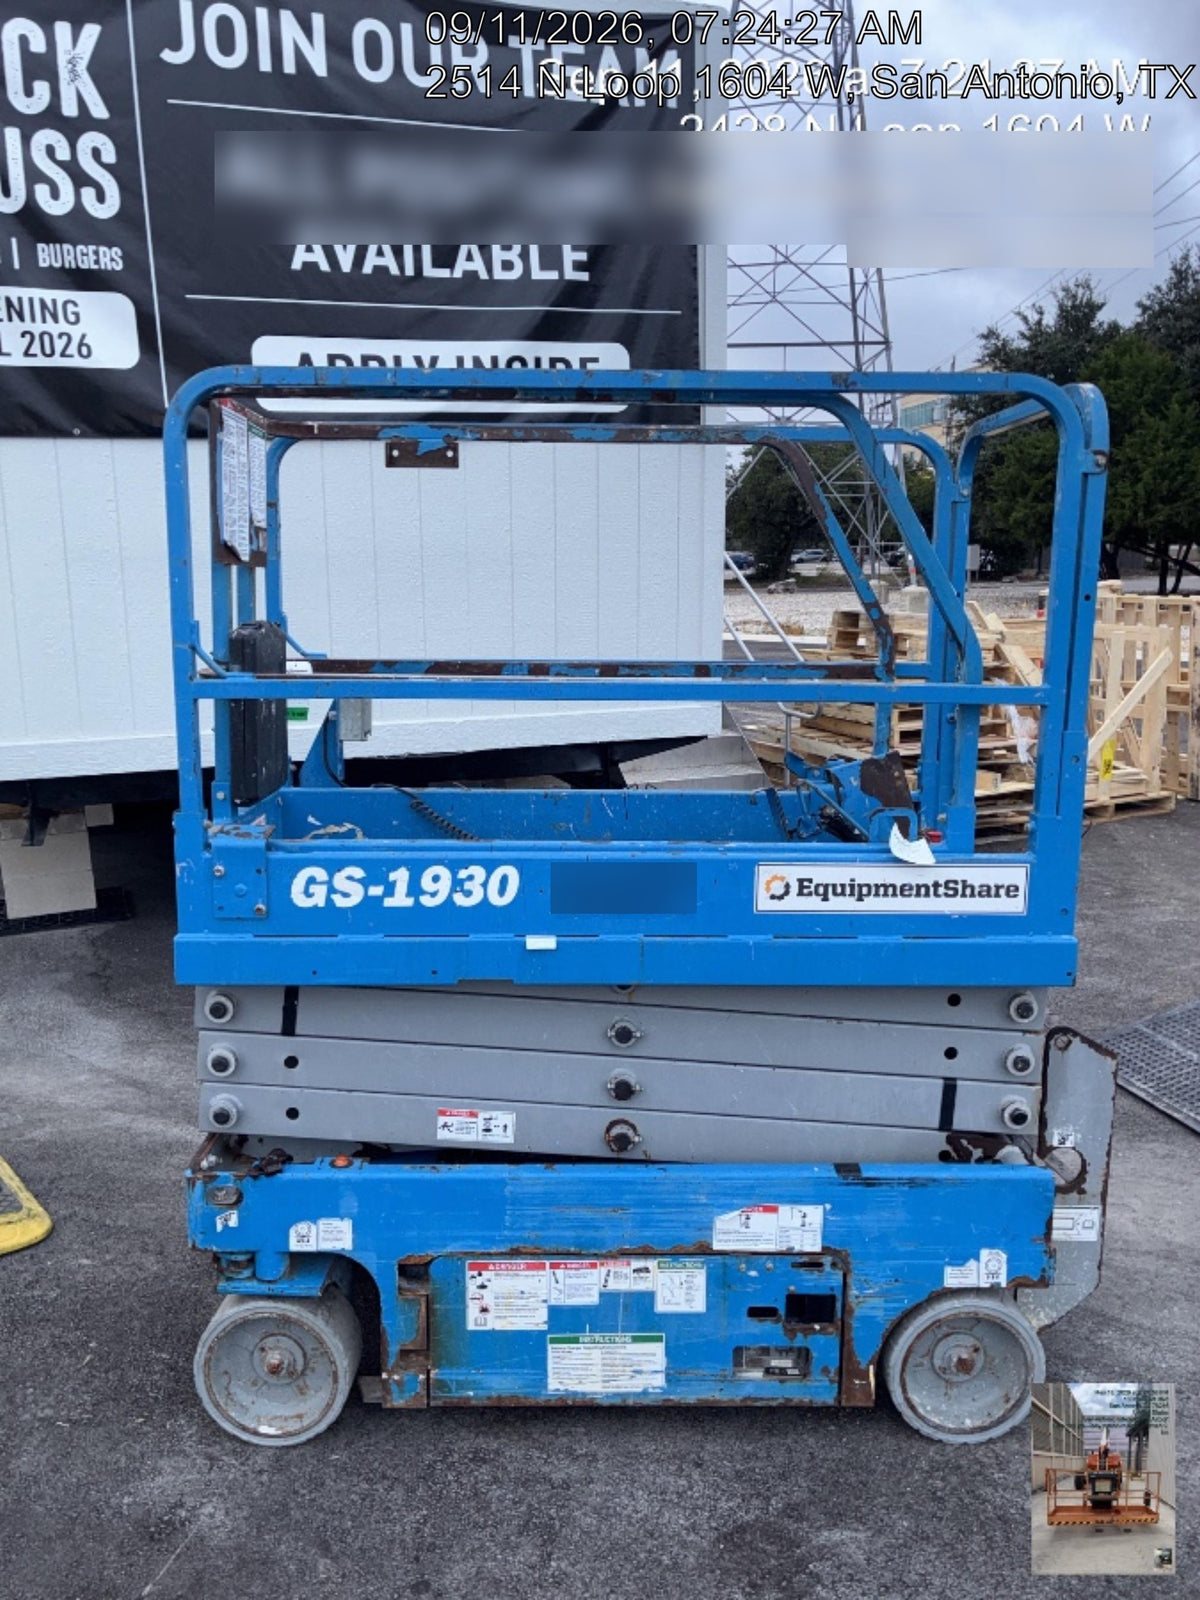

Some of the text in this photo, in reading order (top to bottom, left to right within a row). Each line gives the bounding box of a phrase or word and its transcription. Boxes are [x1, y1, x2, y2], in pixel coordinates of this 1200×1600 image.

[159, 0, 328, 78] JOIN
[351, 18, 492, 94] OUR
[36, 242, 124, 271] BURGERS
[290, 244, 591, 283] AVAILABLE
[0, 295, 81, 326] NING
[20, 330, 93, 360] 2026
[290, 864, 520, 908] GS-1930
[796, 878, 1020, 902] EquipmentShare
